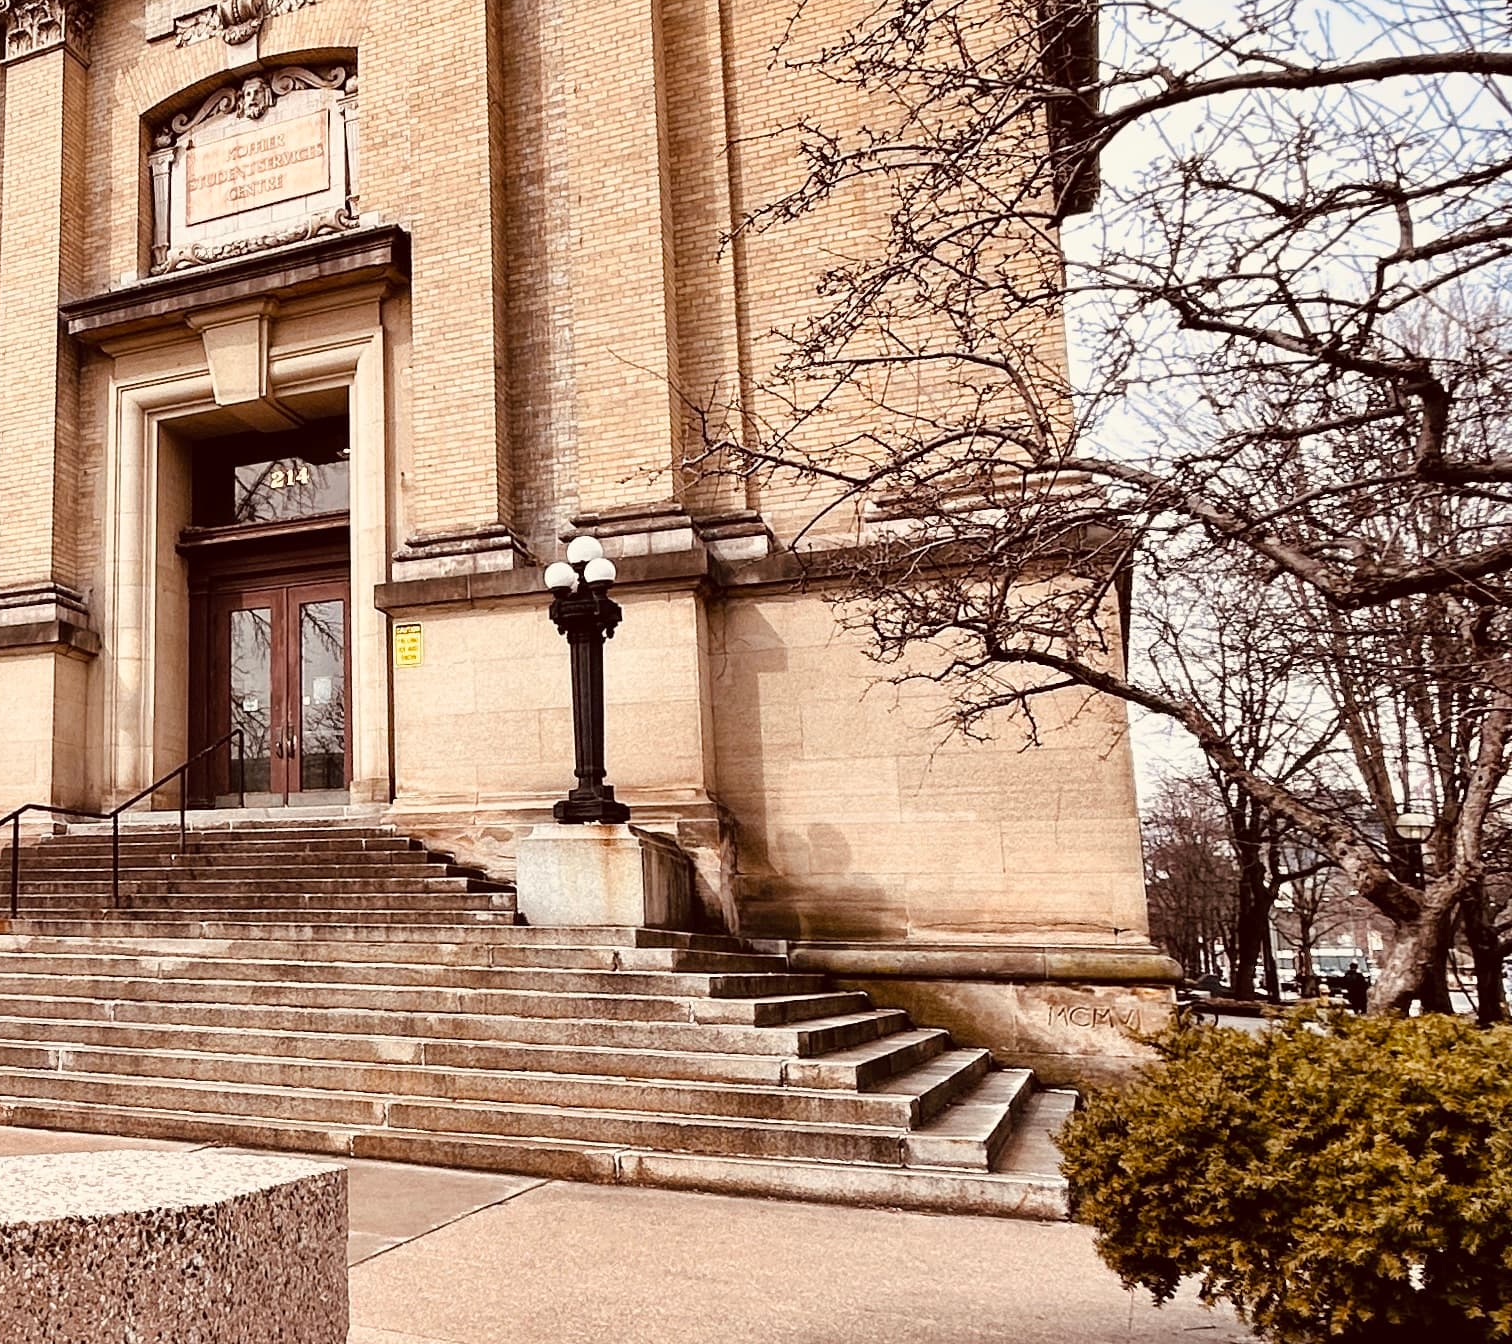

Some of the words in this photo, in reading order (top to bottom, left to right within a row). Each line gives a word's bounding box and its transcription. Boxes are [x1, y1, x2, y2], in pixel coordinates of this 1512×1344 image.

[188, 162, 254, 192] STUDENT
[256, 142, 325, 173] SERVICES
[228, 173, 285, 201] CENTRE
